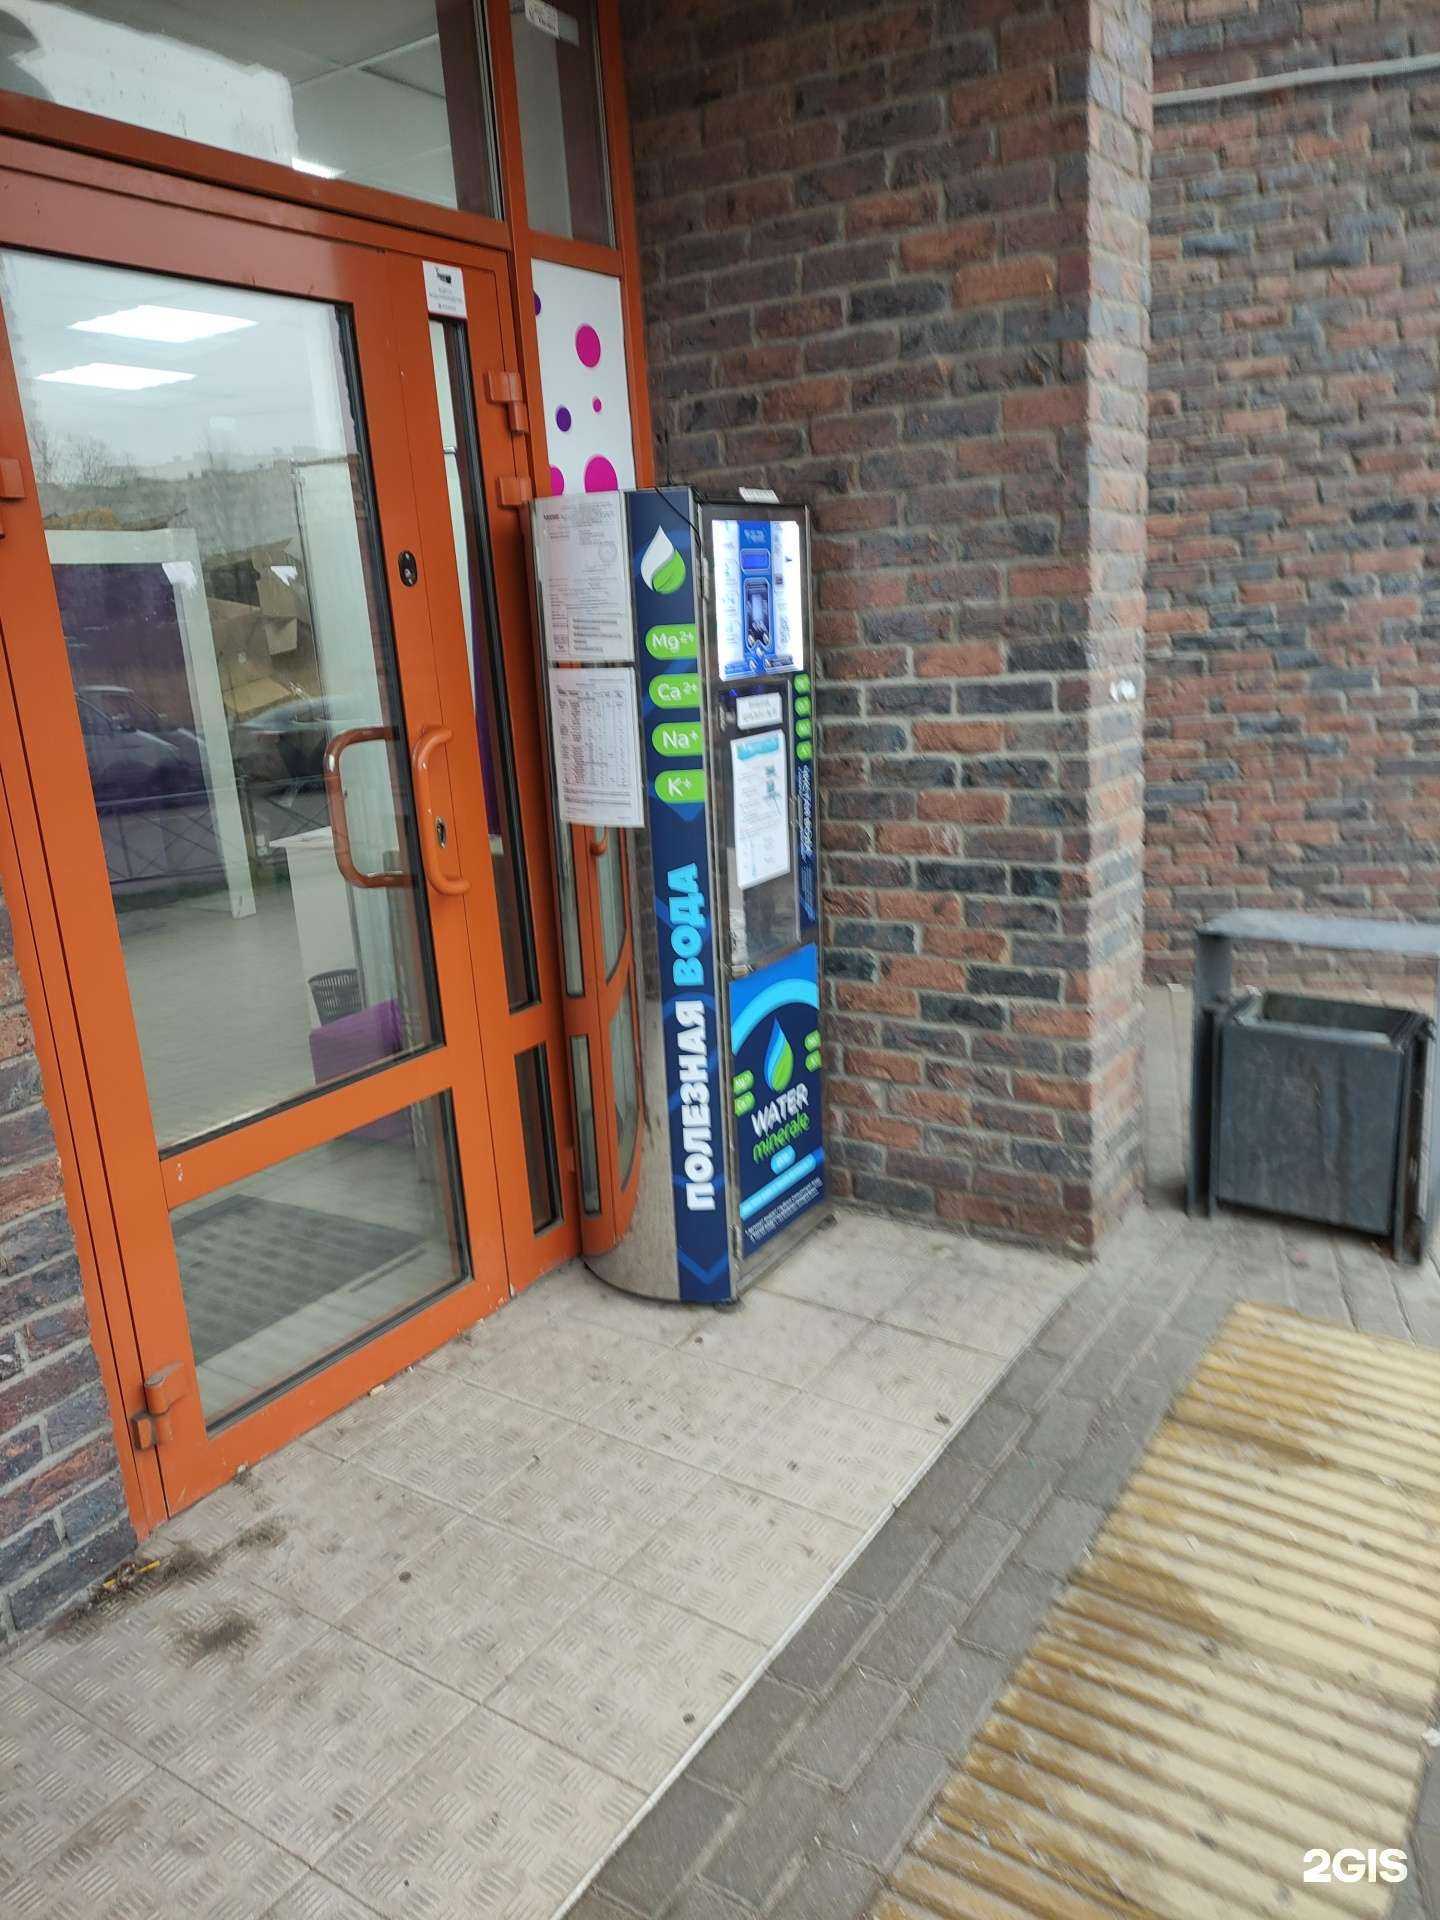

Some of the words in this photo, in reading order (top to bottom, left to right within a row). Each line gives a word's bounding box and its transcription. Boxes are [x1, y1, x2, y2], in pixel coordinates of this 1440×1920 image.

[667, 862, 706, 986] ВОДА
[675, 1000, 716, 1211] ПОЛЕЗНАЯ
[751, 1083, 809, 1137] WATER
